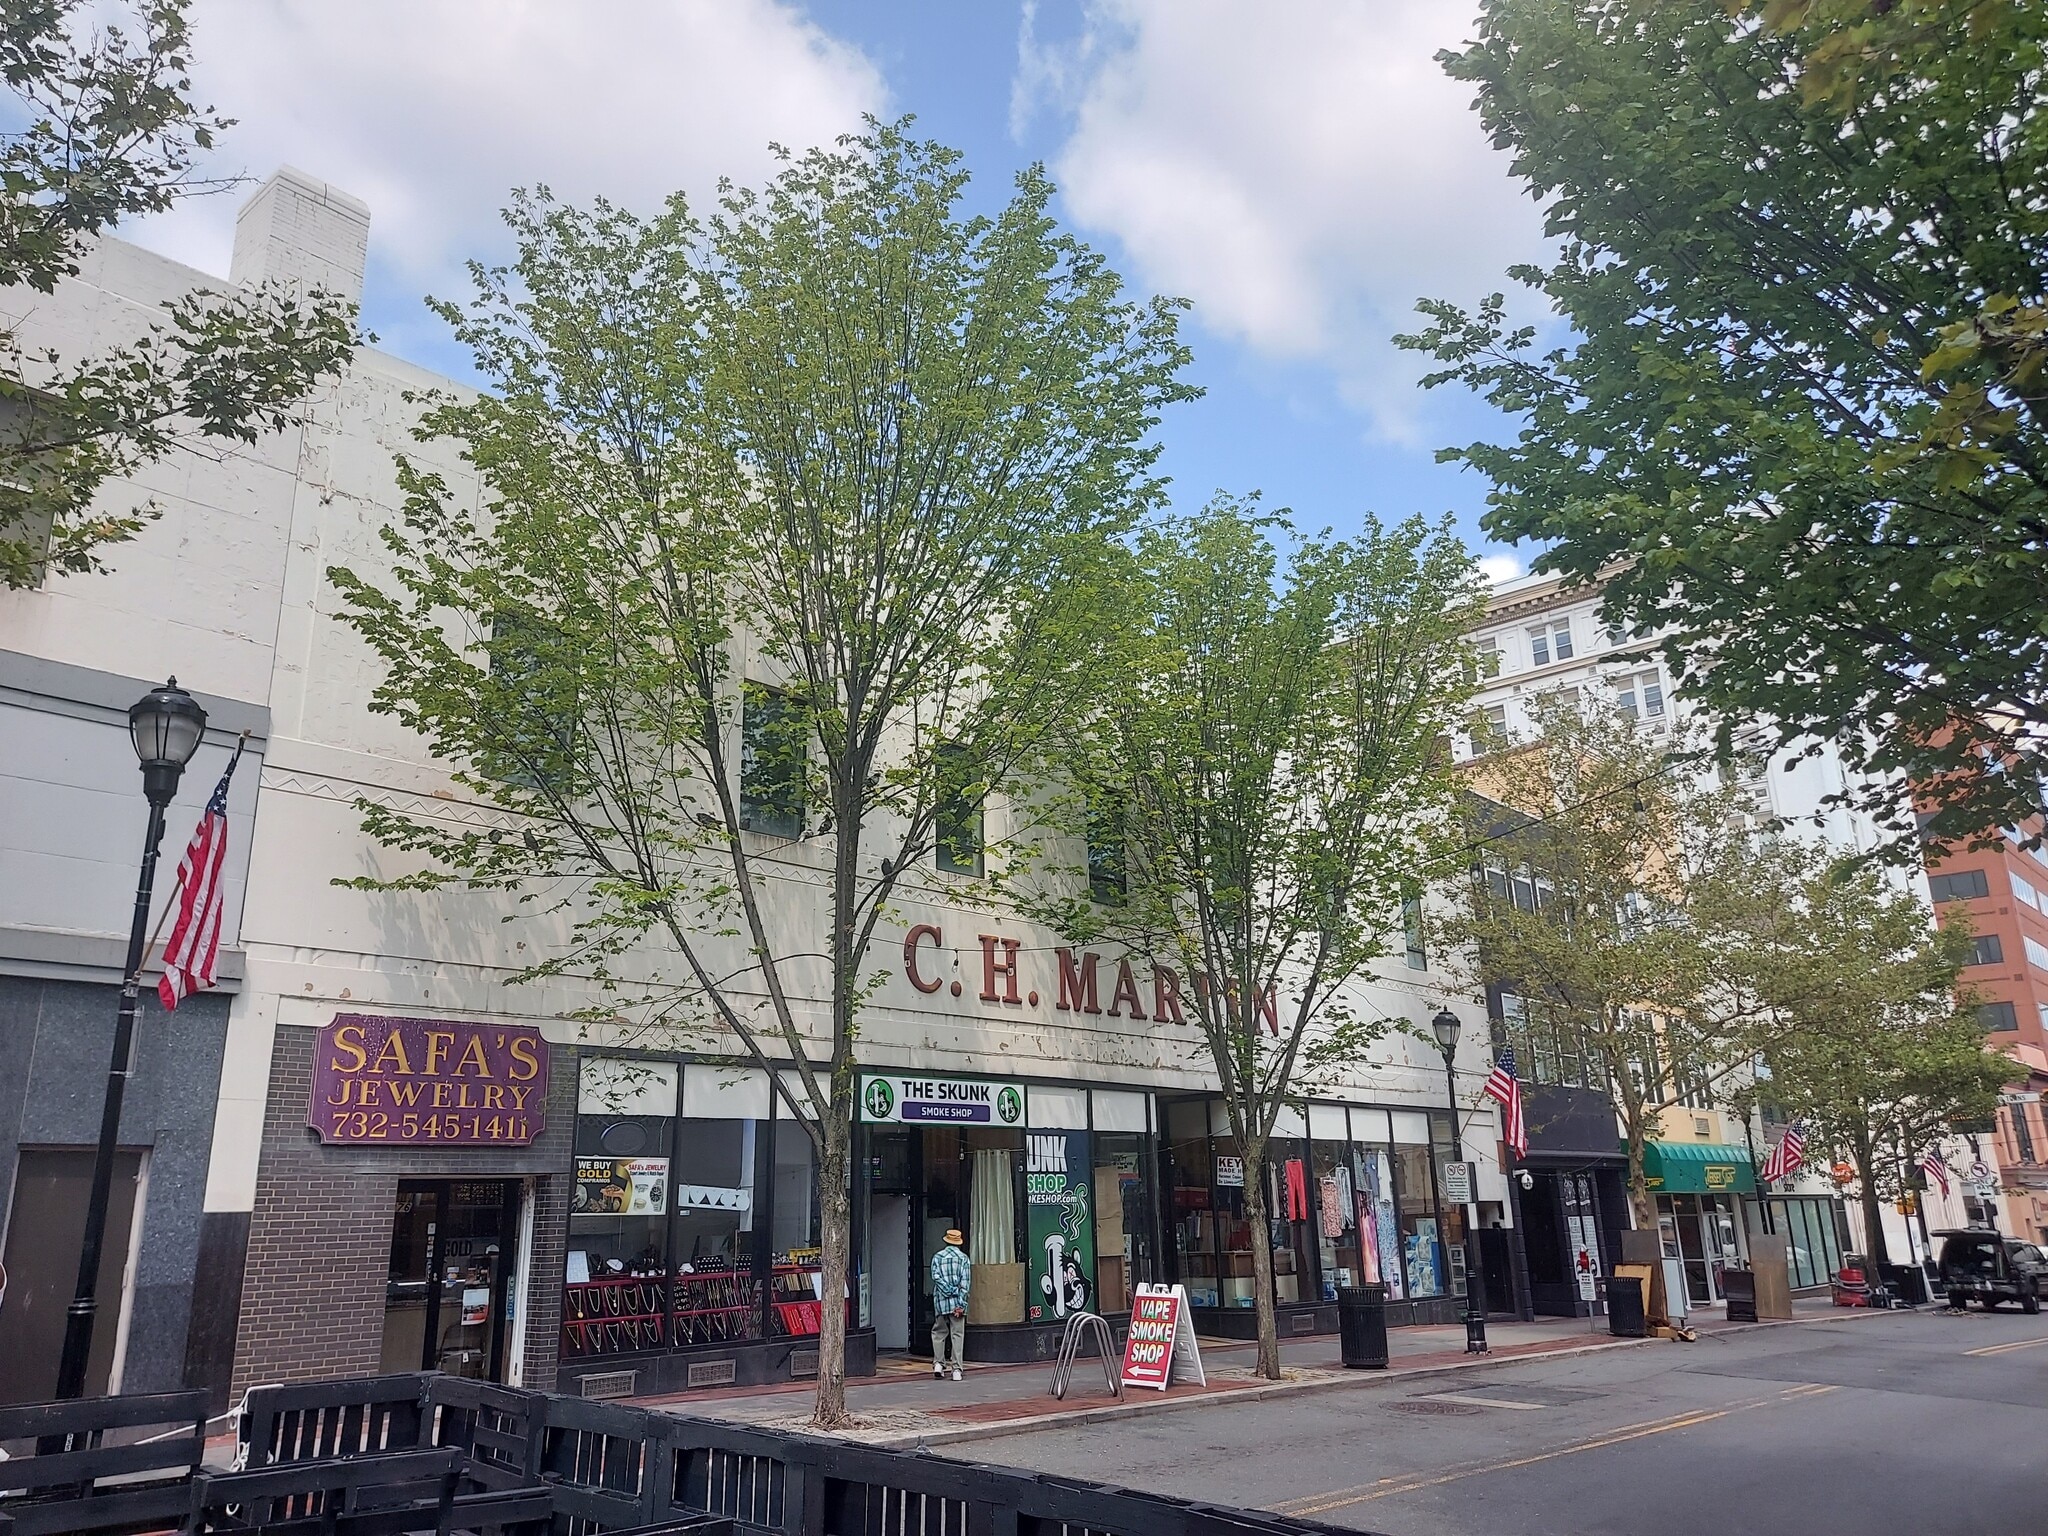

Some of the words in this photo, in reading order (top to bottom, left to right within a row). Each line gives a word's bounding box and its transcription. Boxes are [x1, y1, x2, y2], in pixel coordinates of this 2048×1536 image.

[331, 1025, 540, 1081] SAFA'S
[327, 1078, 535, 1110] JEWELRY
[902, 1081, 934, 1099] THE
[938, 1083, 991, 1102] SKUNK
[921, 1106, 950, 1117] SMOKE
[951, 1108, 973, 1118] SHOP
[332, 1111, 529, 1140] 732-545-1411
[577, 1169, 611, 1178] GOLD
[578, 1160, 592, 1169] WE
[593, 1161, 611, 1170] BUY
[1027, 1174, 1068, 1193] SHOP
[1140, 1300, 1171, 1320] VAPE
[1130, 1321, 1173, 1342] SMOKE
[1131, 1342, 1165, 1364] SHOP
